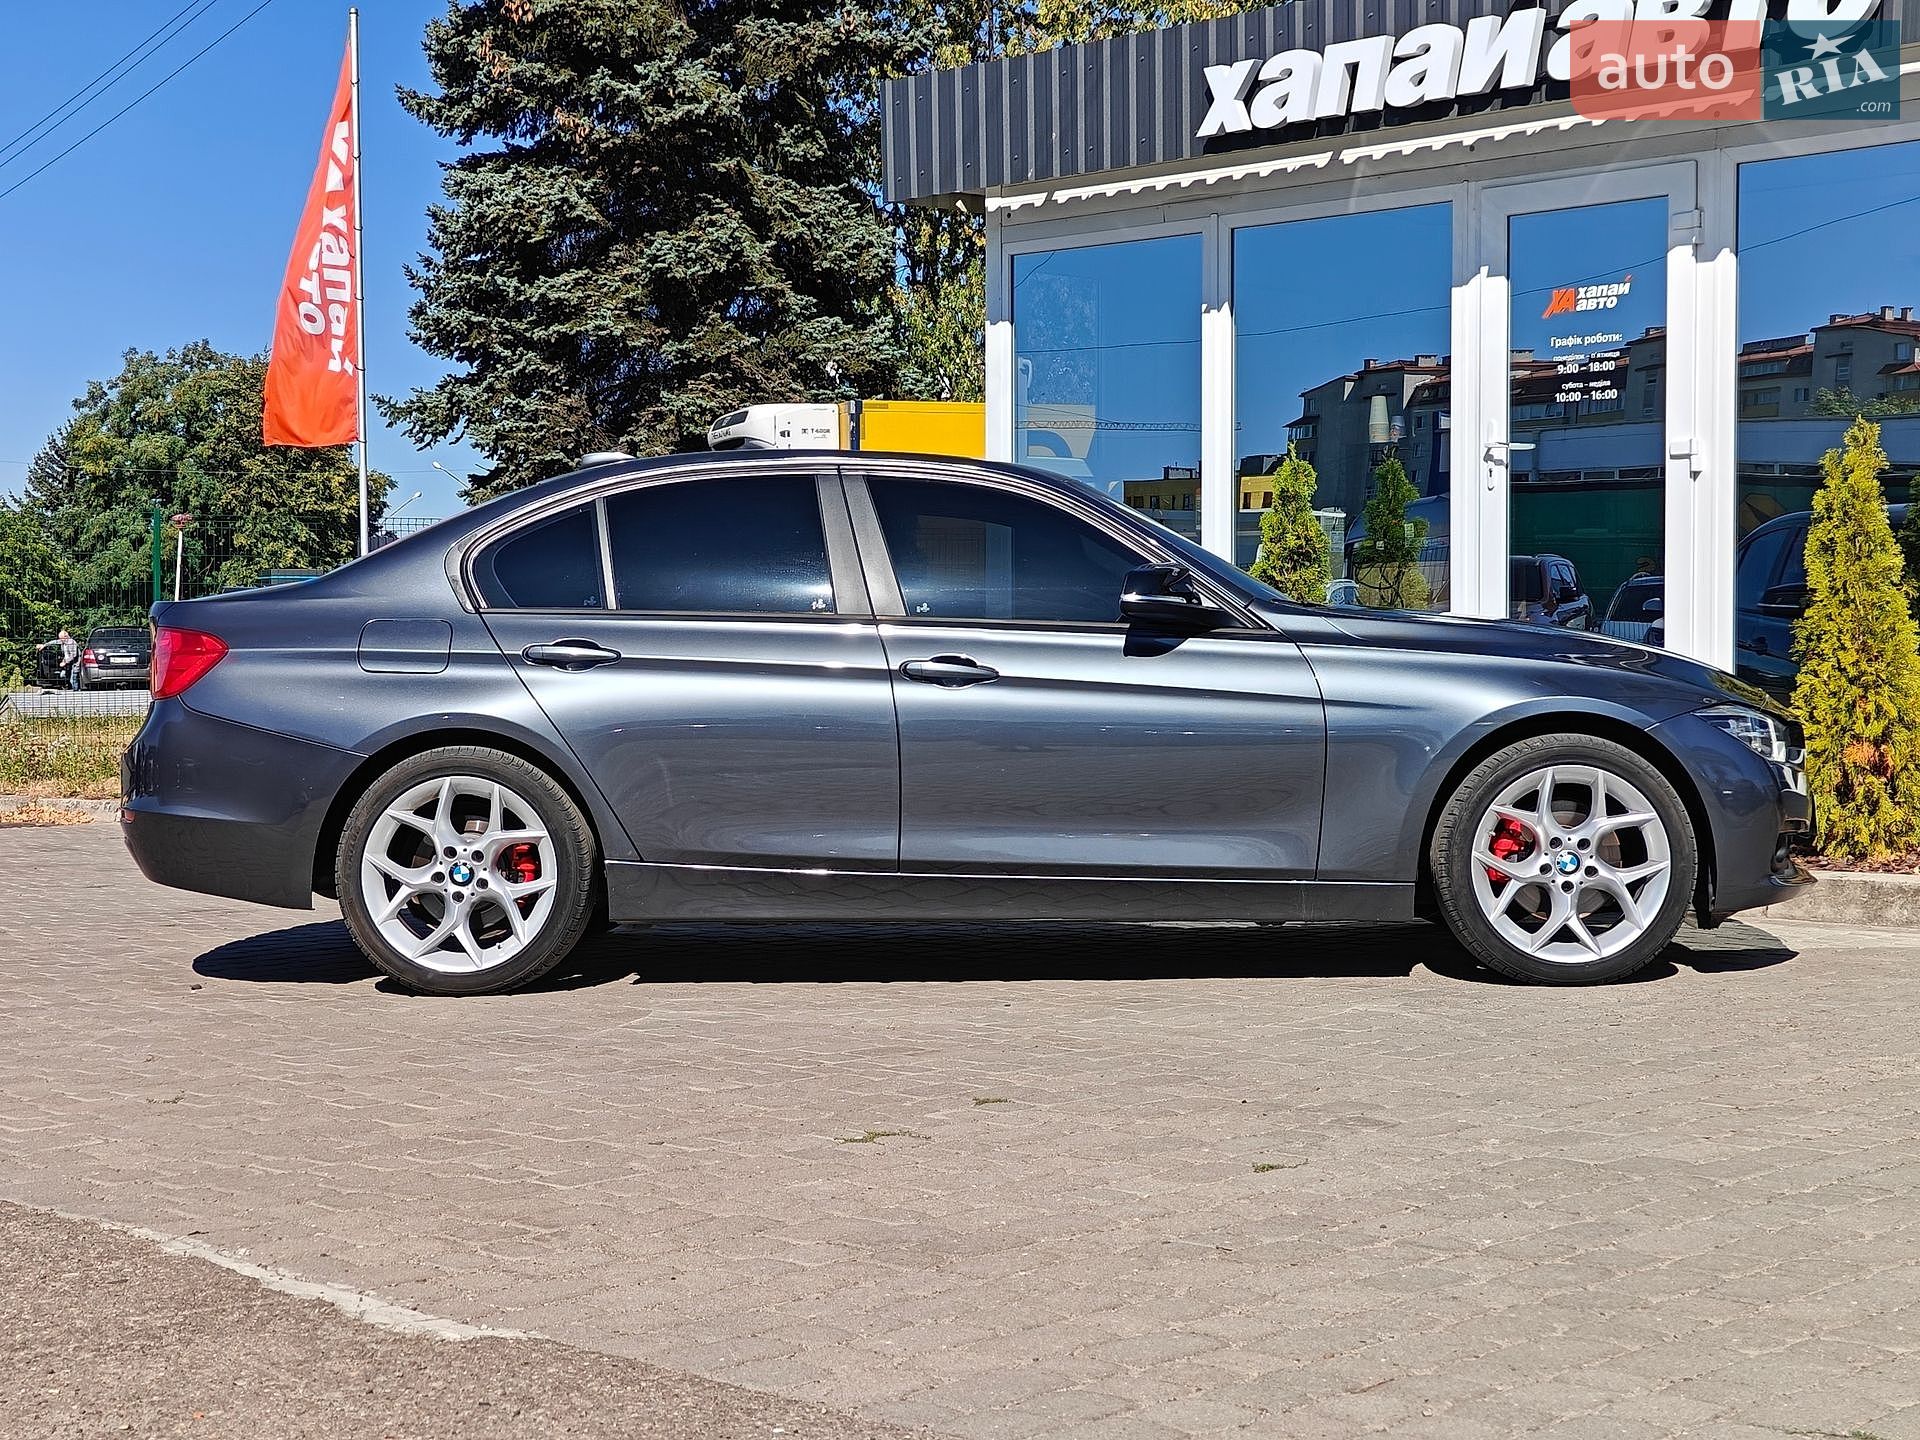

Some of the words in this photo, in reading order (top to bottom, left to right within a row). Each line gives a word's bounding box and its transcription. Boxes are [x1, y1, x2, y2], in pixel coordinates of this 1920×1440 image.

[1576, 296, 1618, 312] авто
[1550, 335, 1583, 348] Графік
[1584, 332, 1623, 347] роботи:
[1557, 363, 1579, 375] 9:00
[1589, 360, 1616, 372] 18:00
[1561, 381, 1584, 391] субота
[1554, 391, 1582, 403] 10:00
[1590, 388, 1618, 401] 16:00
